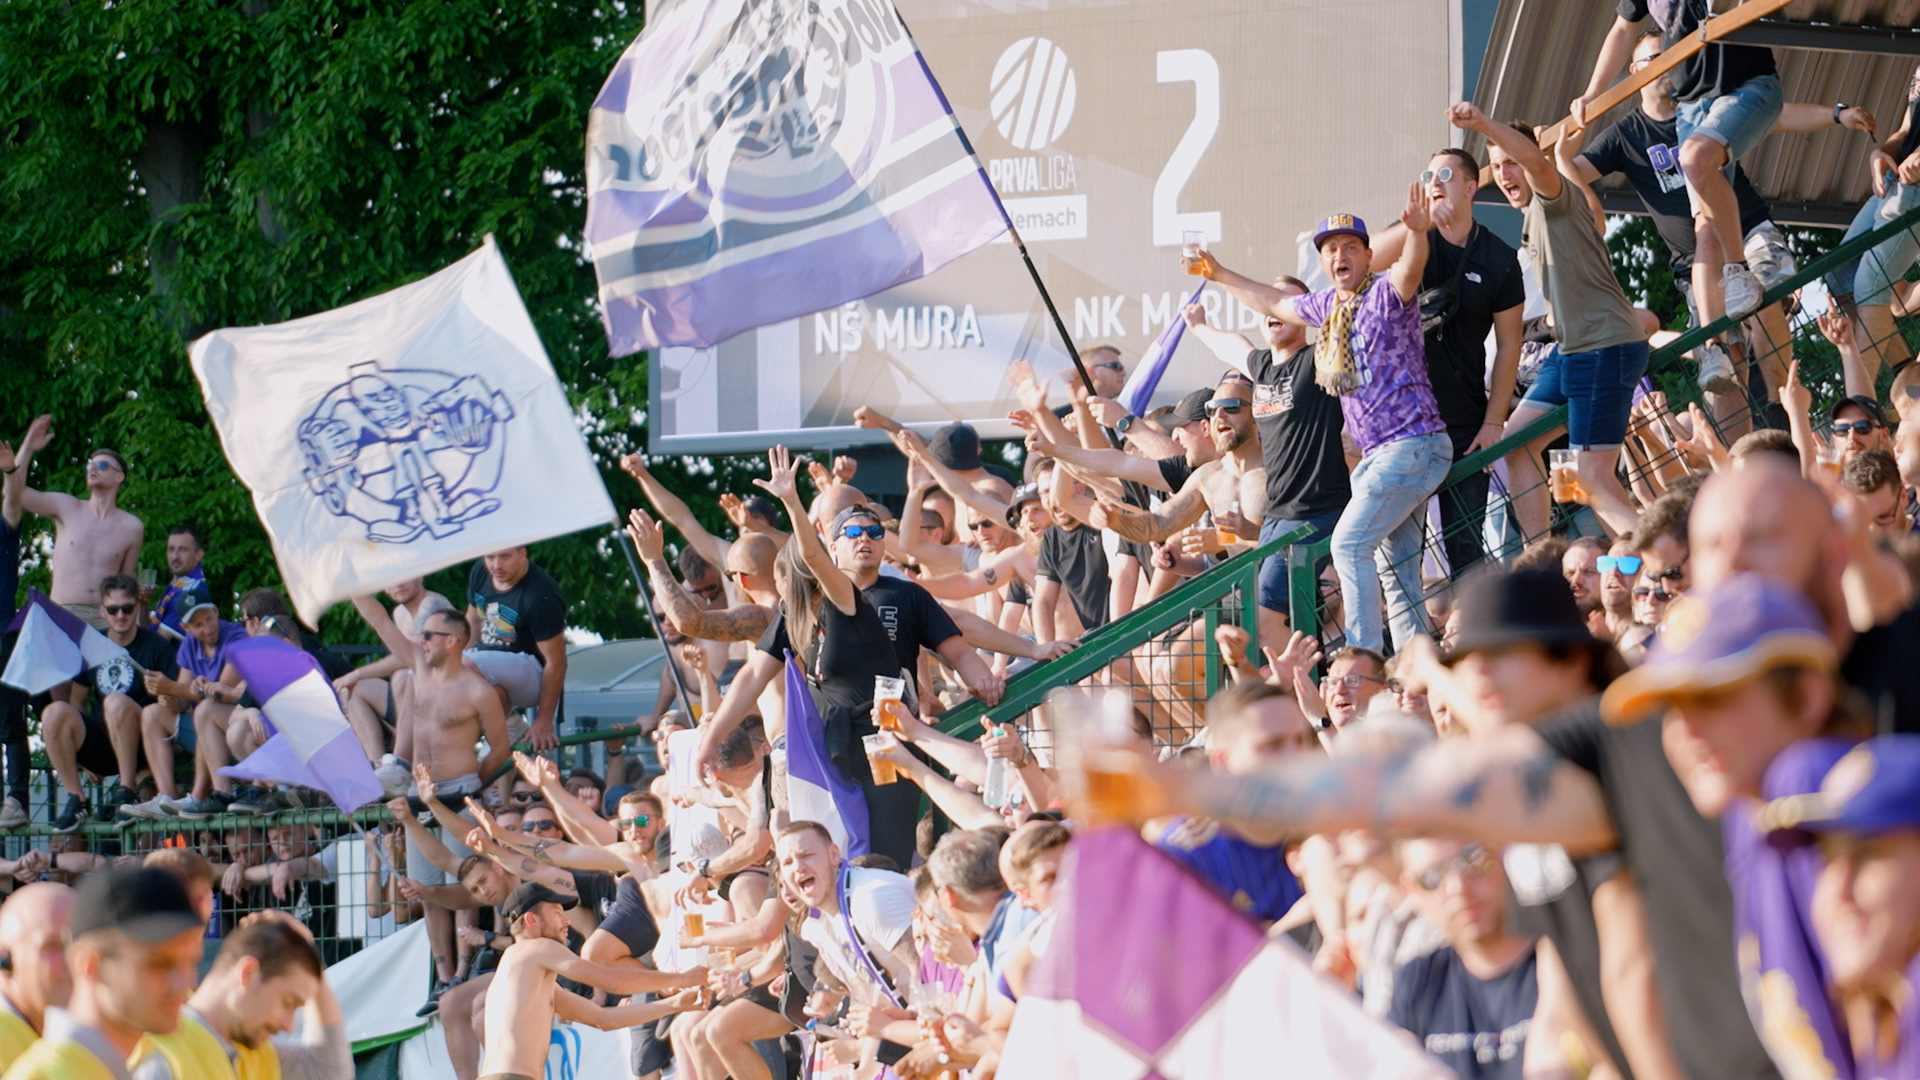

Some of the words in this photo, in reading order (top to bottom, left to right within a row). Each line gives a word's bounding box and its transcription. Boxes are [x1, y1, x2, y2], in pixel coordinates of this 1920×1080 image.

[1153, 48, 1221, 246] 2
[815, 300, 863, 354] NŠ
[876, 303, 984, 351] MURA
[1074, 294, 1127, 339] NK
